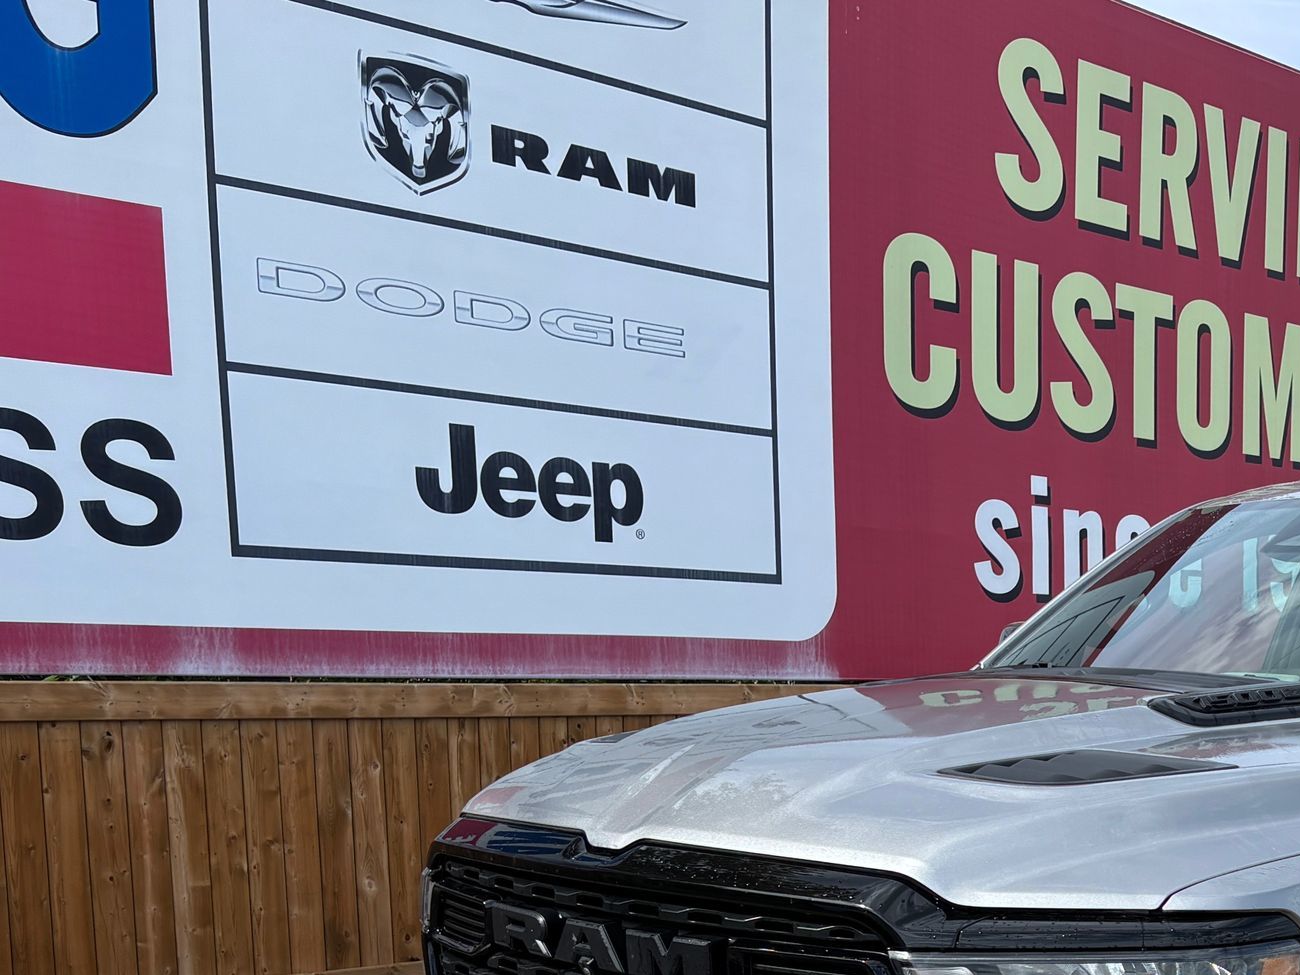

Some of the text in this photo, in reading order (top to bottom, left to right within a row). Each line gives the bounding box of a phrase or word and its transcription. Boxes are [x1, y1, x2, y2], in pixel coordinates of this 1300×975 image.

[490, 124, 697, 208] RAM
[255, 257, 686, 359] DODGE
[415, 423, 644, 543] Jeep
